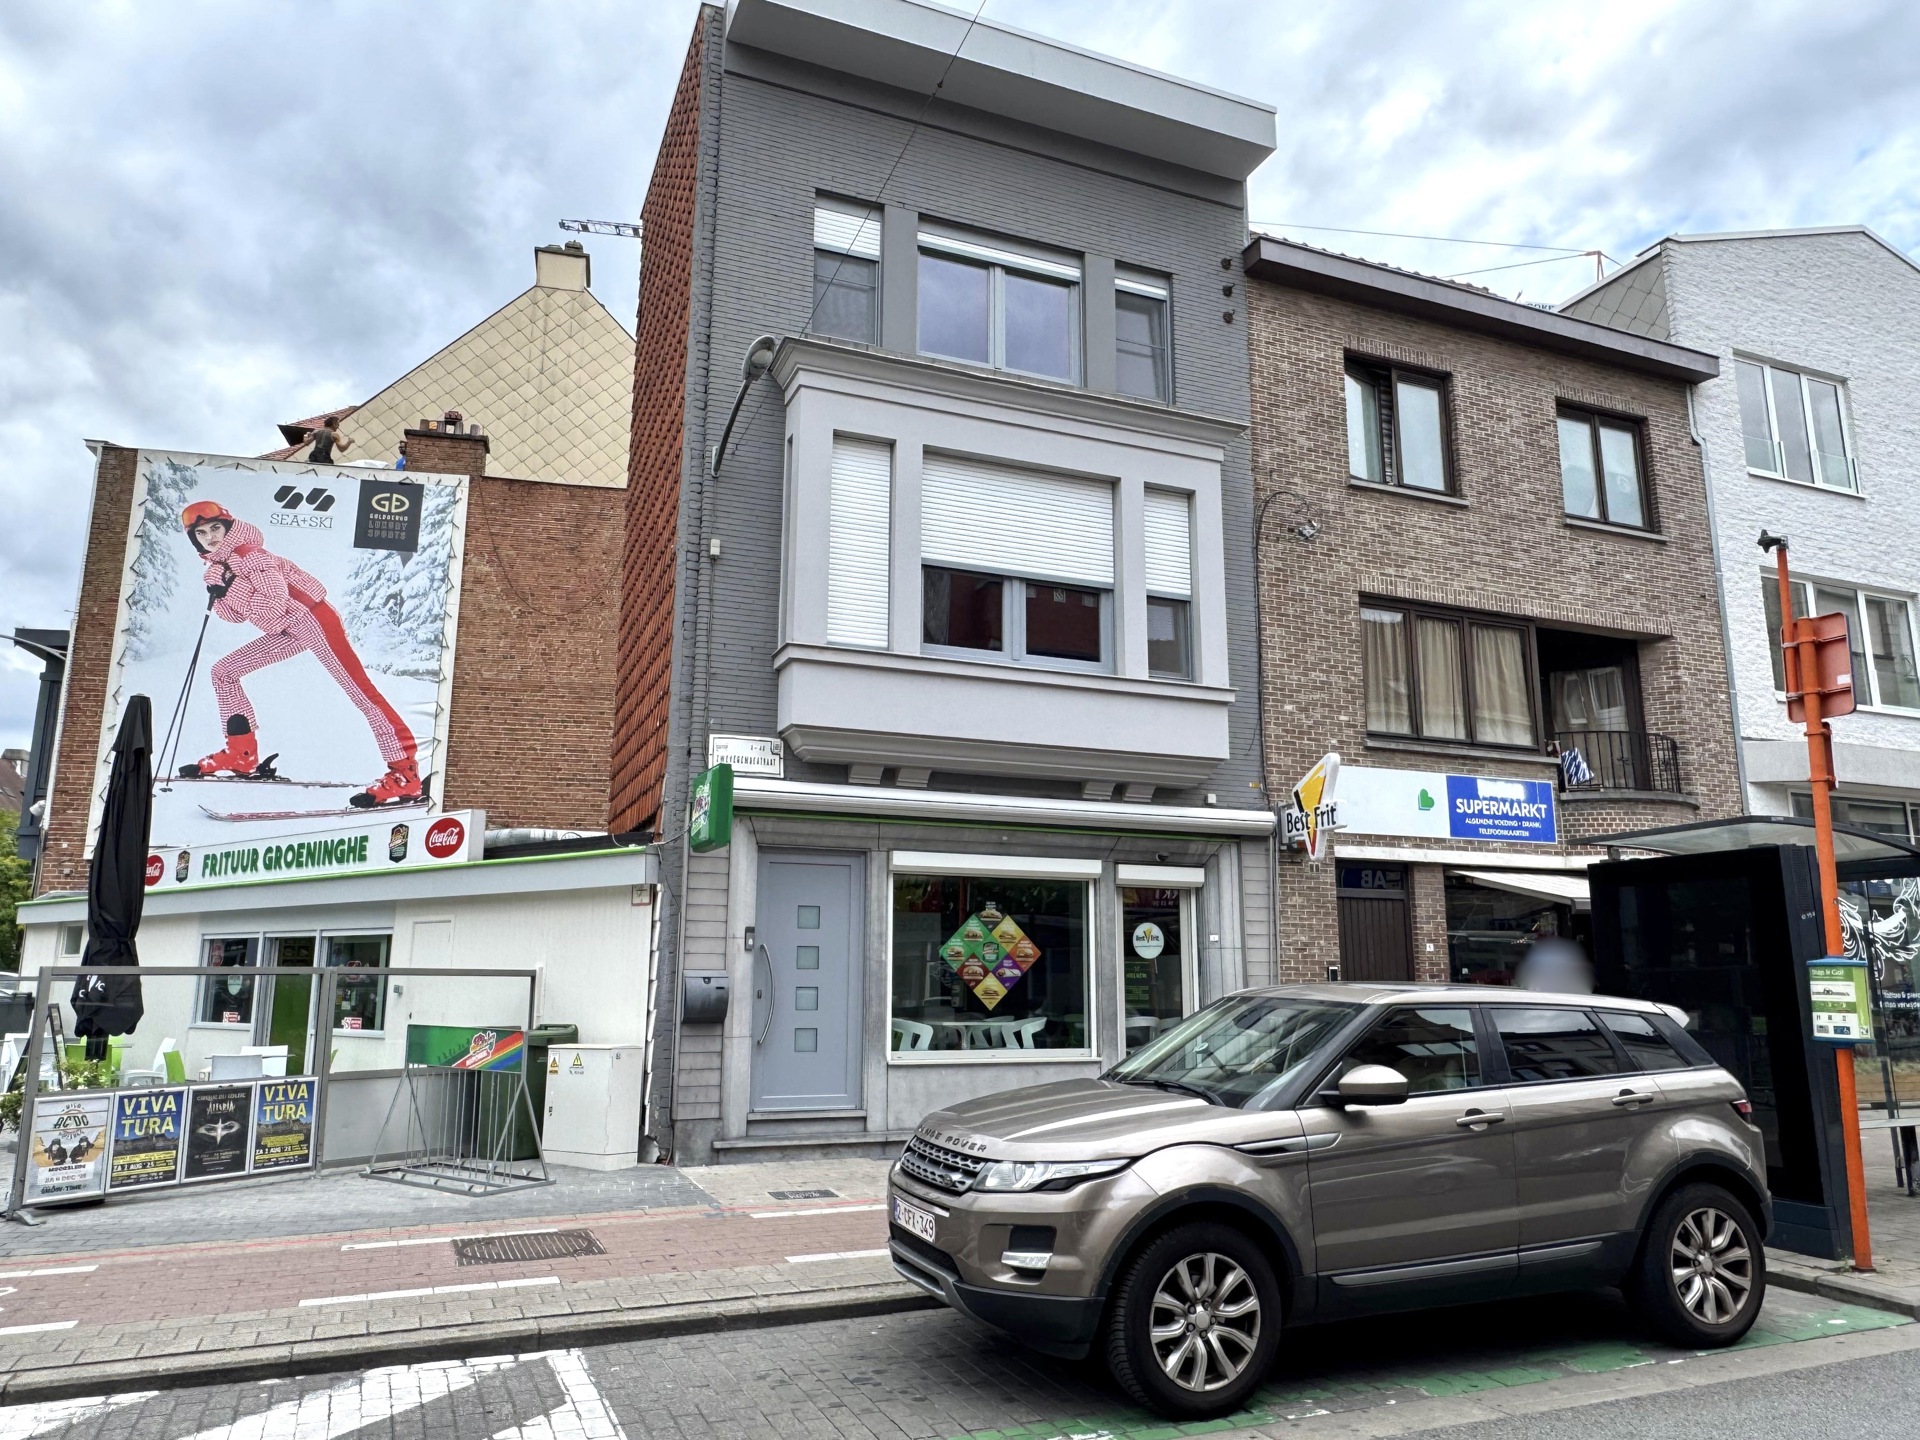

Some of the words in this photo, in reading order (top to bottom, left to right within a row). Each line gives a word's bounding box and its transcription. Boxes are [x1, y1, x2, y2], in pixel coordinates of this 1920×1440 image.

[270, 513, 333, 529] SEA+SKI
[368, 520, 407, 531] LUXURY
[367, 529, 407, 540] SPORTS
[1456, 799, 1547, 818] SUPERMARKT
[1286, 811, 1311, 834] Best
[1314, 803, 1337, 829] Frit
[1494, 819, 1518, 827] VOEDING
[1479, 828, 1529, 836] TELEFOONKAARTEN
[202, 848, 259, 878] FRITUUR
[263, 835, 368, 871] GROENINGHE
[264, 1083, 308, 1102] VIVA
[123, 1095, 176, 1115] VIVA
[262, 1103, 307, 1121] TURA
[121, 1116, 174, 1137] TURA
[944, 1136, 987, 1153] ROVER
